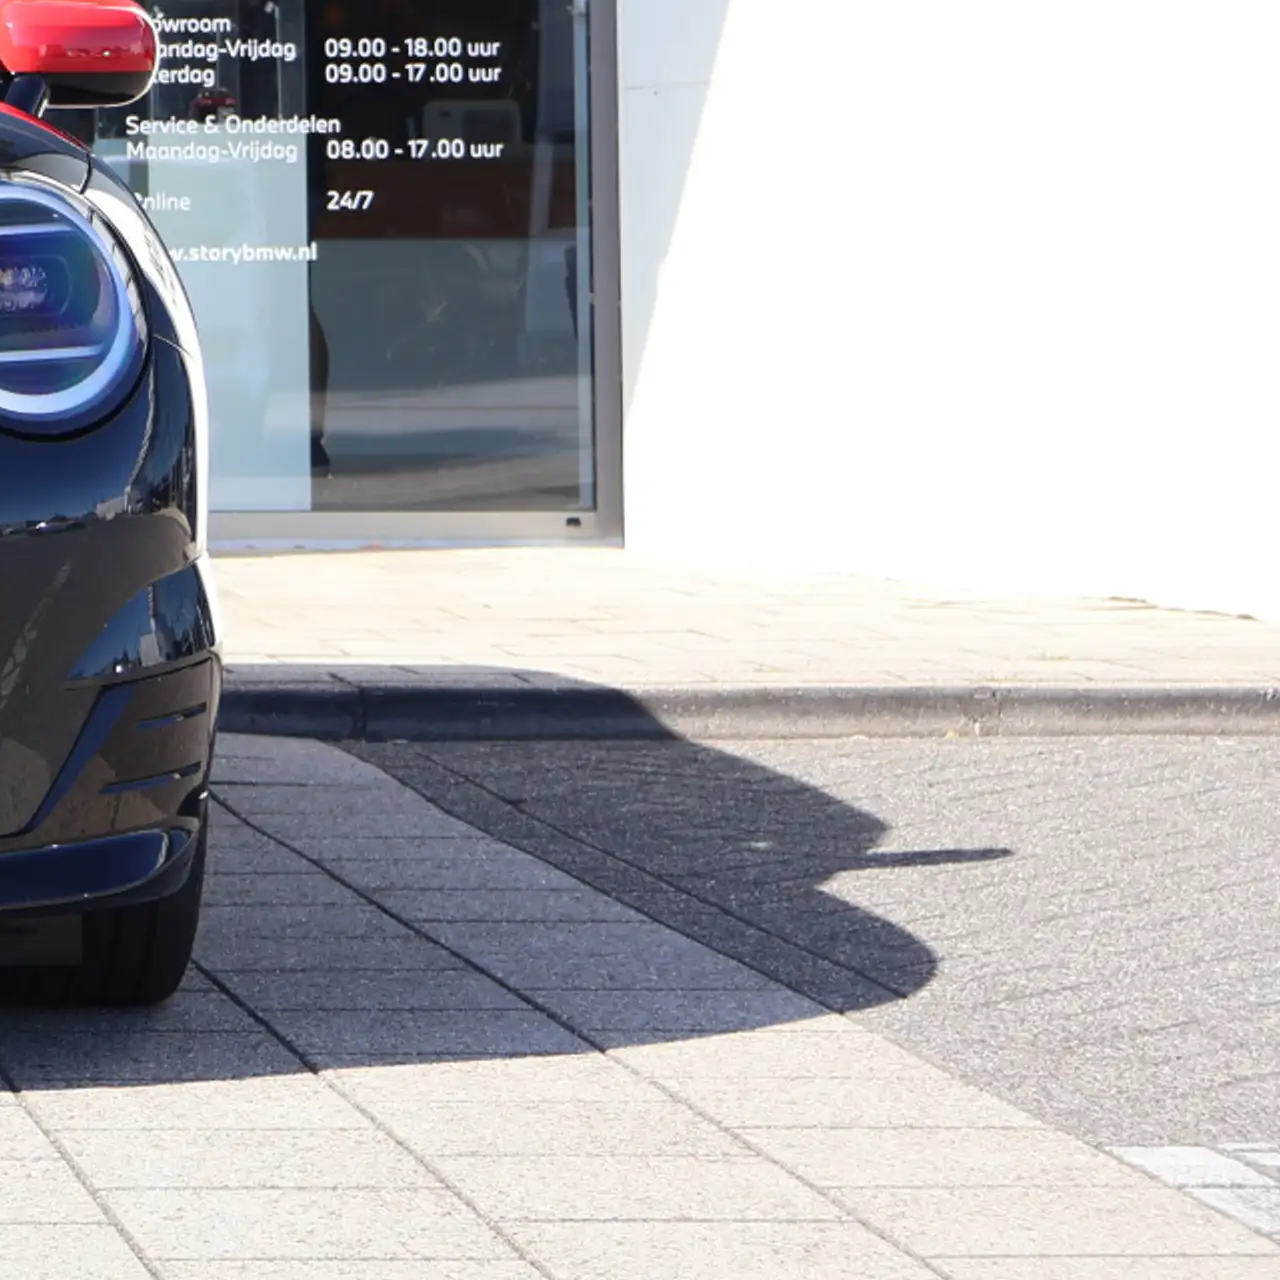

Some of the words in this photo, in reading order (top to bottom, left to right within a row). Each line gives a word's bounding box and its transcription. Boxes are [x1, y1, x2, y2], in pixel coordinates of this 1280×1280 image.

[153, 17, 230, 33] owroom
[159, 39, 297, 61] andag-Vrijdag
[325, 38, 385, 57] 09.00
[405, 38, 461, 57] 18.00
[468, 42, 500, 56] uur
[326, 64, 386, 83] 09.00
[469, 68, 501, 81] uur
[125, 116, 198, 135] Service
[203, 116, 219, 135] &
[224, 116, 341, 135] Onderdelen
[126, 141, 299, 163] Maandag-Vrijdag
[327, 140, 389, 159] 08.00
[470, 143, 504, 160] uur
[327, 191, 373, 210] 24/7
